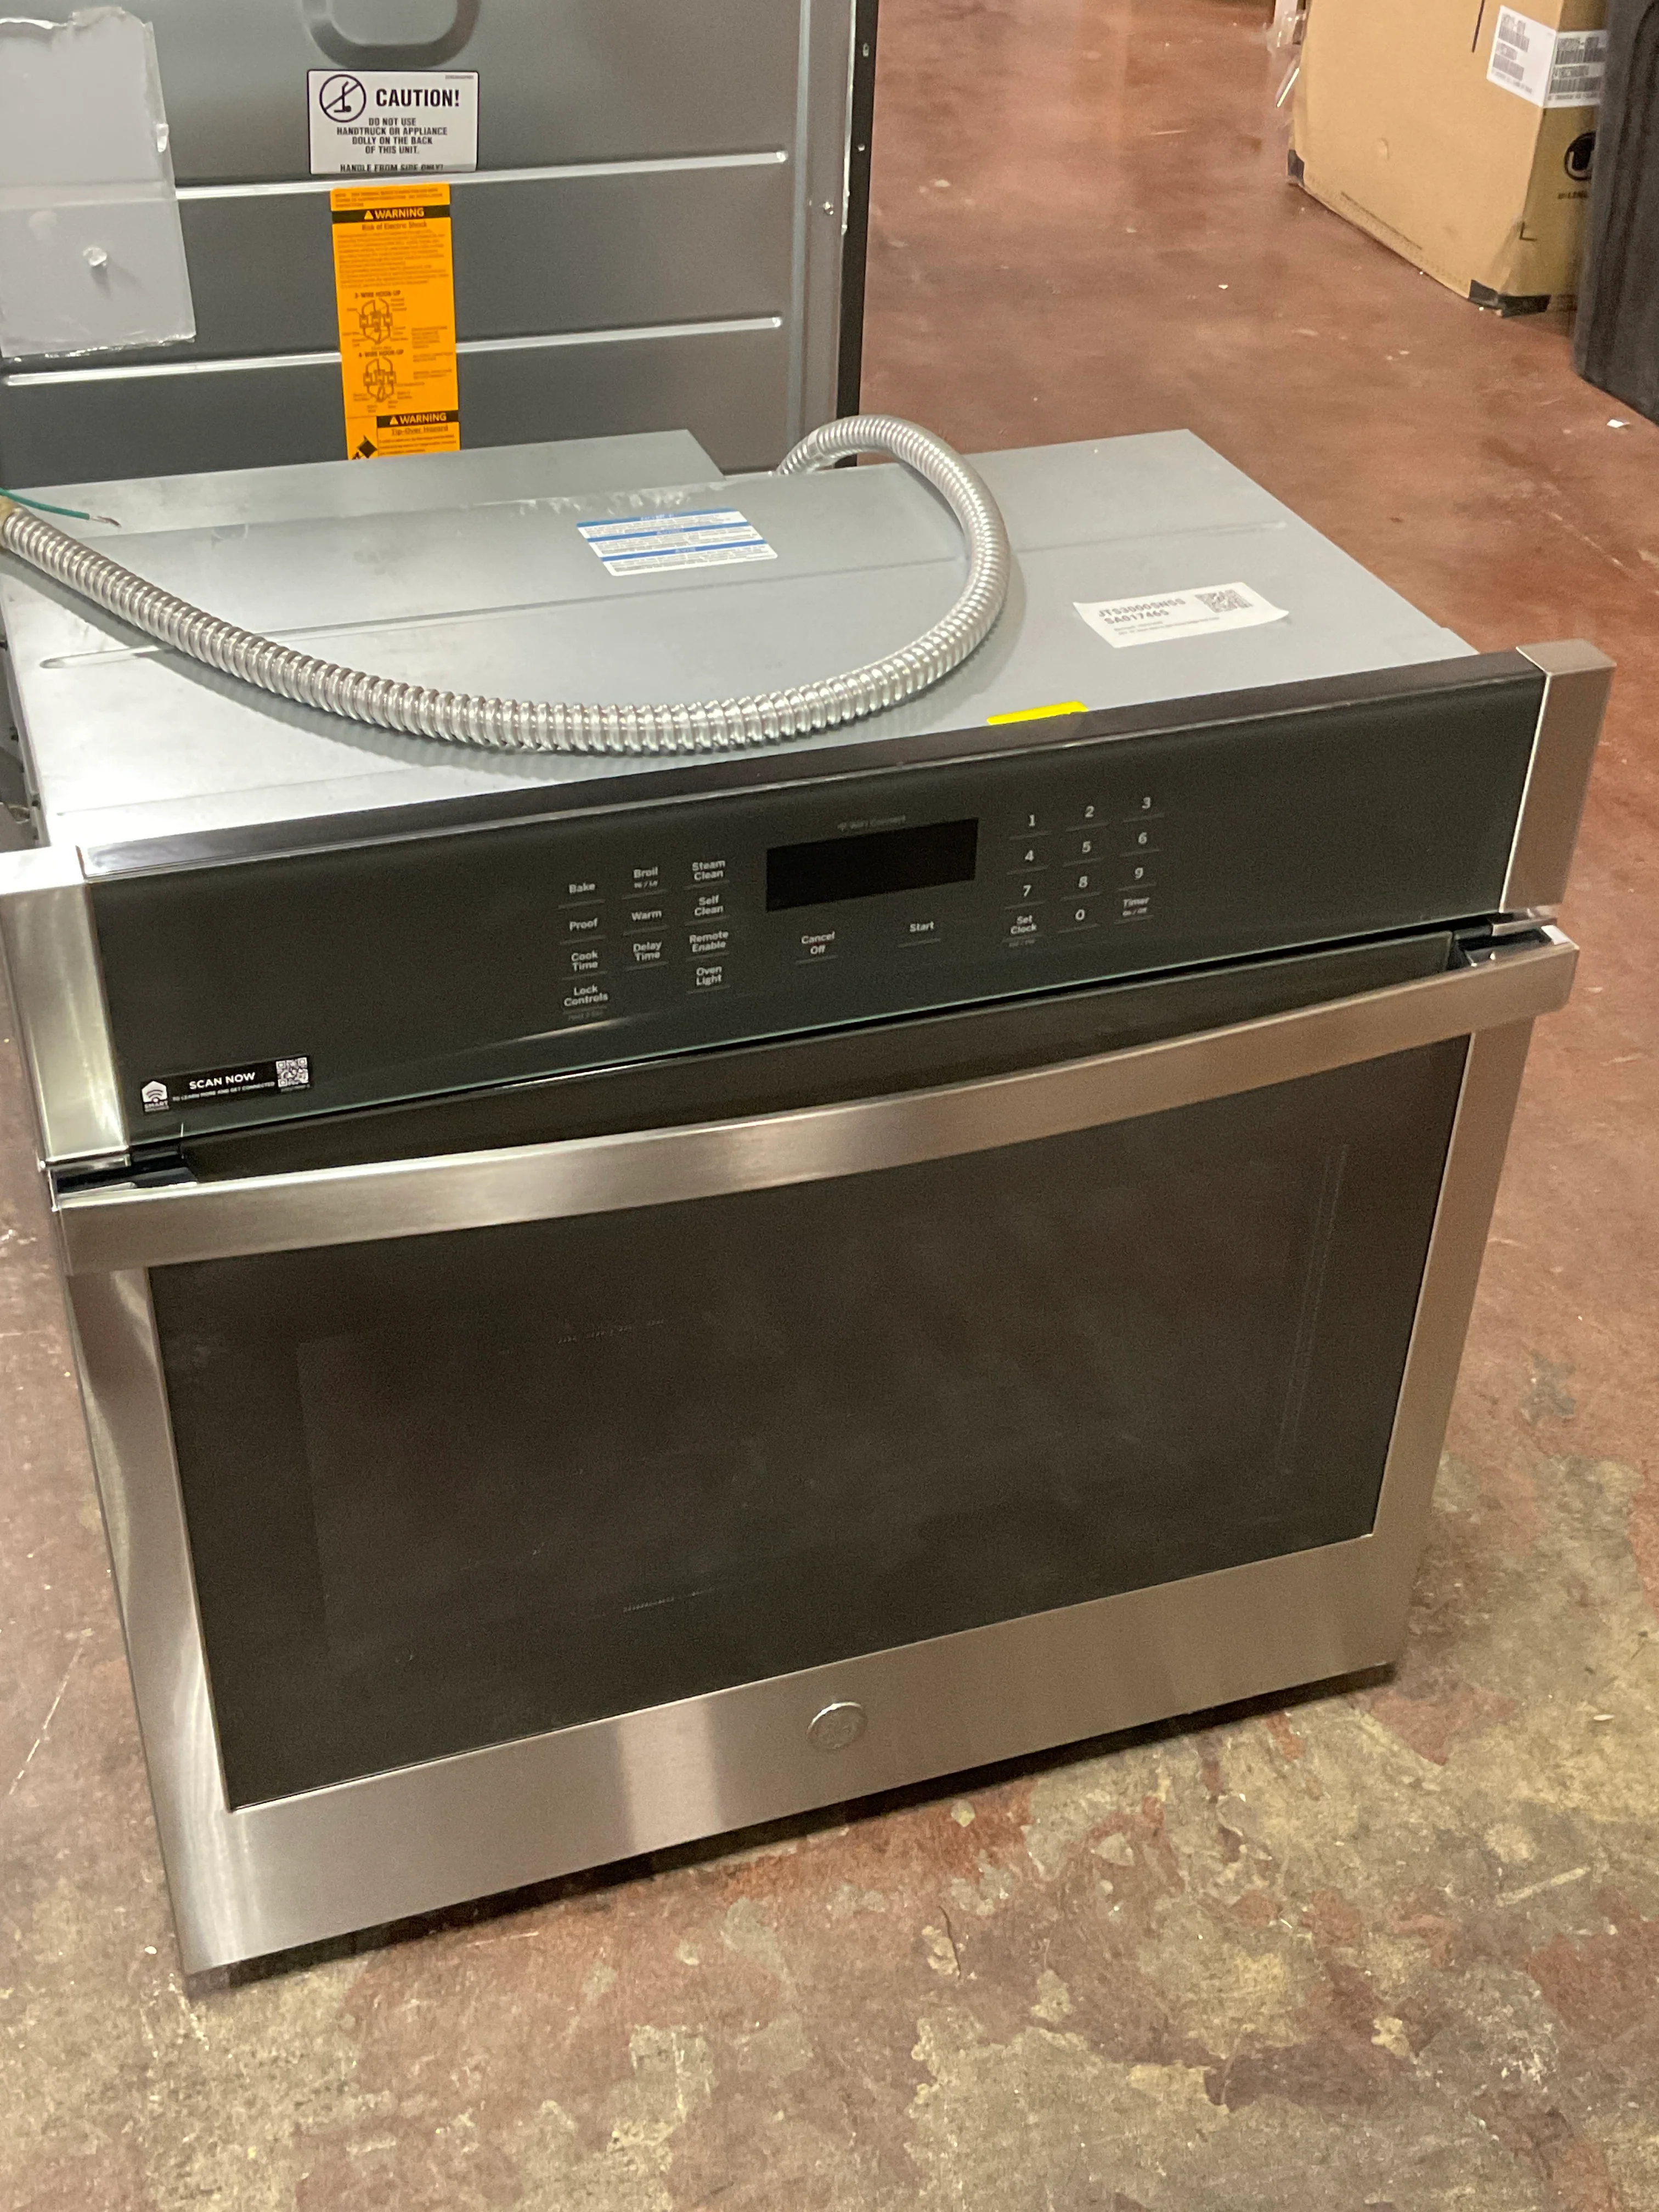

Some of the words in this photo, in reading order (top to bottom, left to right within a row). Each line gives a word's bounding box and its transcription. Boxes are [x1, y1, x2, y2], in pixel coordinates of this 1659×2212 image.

[376, 89, 459, 106] CAUTION!
[369, 117, 380, 126] DO
[382, 117, 398, 126] NOT
[401, 117, 416, 126] USE
[337, 127, 385, 136] HANDTRUCK
[403, 127, 447, 136] APPLIANCE
[352, 137, 375, 145] DOLLY
[411, 137, 432, 145] BACK
[365, 146, 375, 154] OF
[399, 146, 419, 154] UNIT.
[340, 164, 371, 172] HANDLE
[375, 207, 424, 219] WARNING
[400, 413, 446, 424] WARNING
[391, 427, 421, 436] Tip-Over
[1142, 797, 1150, 809] 3
[1085, 806, 1094, 817] 2
[1029, 815, 1035, 826] 1
[1138, 832, 1147, 844] 6
[1082, 841, 1091, 853] 5
[1025, 850, 1034, 861] 4
[692, 860, 725, 871] Steam
[633, 866, 658, 879] Broil
[694, 870, 724, 881] Clean
[1135, 867, 1143, 879] 9
[1079, 876, 1087, 888] 8
[569, 883, 595, 894] Bake
[1023, 885, 1031, 896] 7
[698, 895, 719, 905] Self
[1124, 897, 1149, 907] Timer
[631, 910, 662, 921] Warm
[694, 906, 724, 916] Clean
[1075, 909, 1085, 921] 0
[570, 918, 598, 931] Proof
[1017, 915, 1032, 924] Set
[910, 921, 934, 933] Start
[1011, 923, 1037, 934] Clock
[690, 931, 729, 944] Remote
[801, 931, 835, 944] Cancel
[633, 941, 662, 952] Delay
[692, 941, 726, 952] Enable
[810, 944, 826, 955] Off
[571, 950, 598, 962] Cook
[635, 951, 661, 961] Time
[572, 961, 598, 972] Time
[696, 966, 722, 976] Oven
[696, 974, 721, 986] Light
[574, 984, 598, 996] Lock
[564, 992, 608, 1007] Controls
[189, 1077, 222, 1090] SCAN
[225, 1071, 256, 1084] NOW
